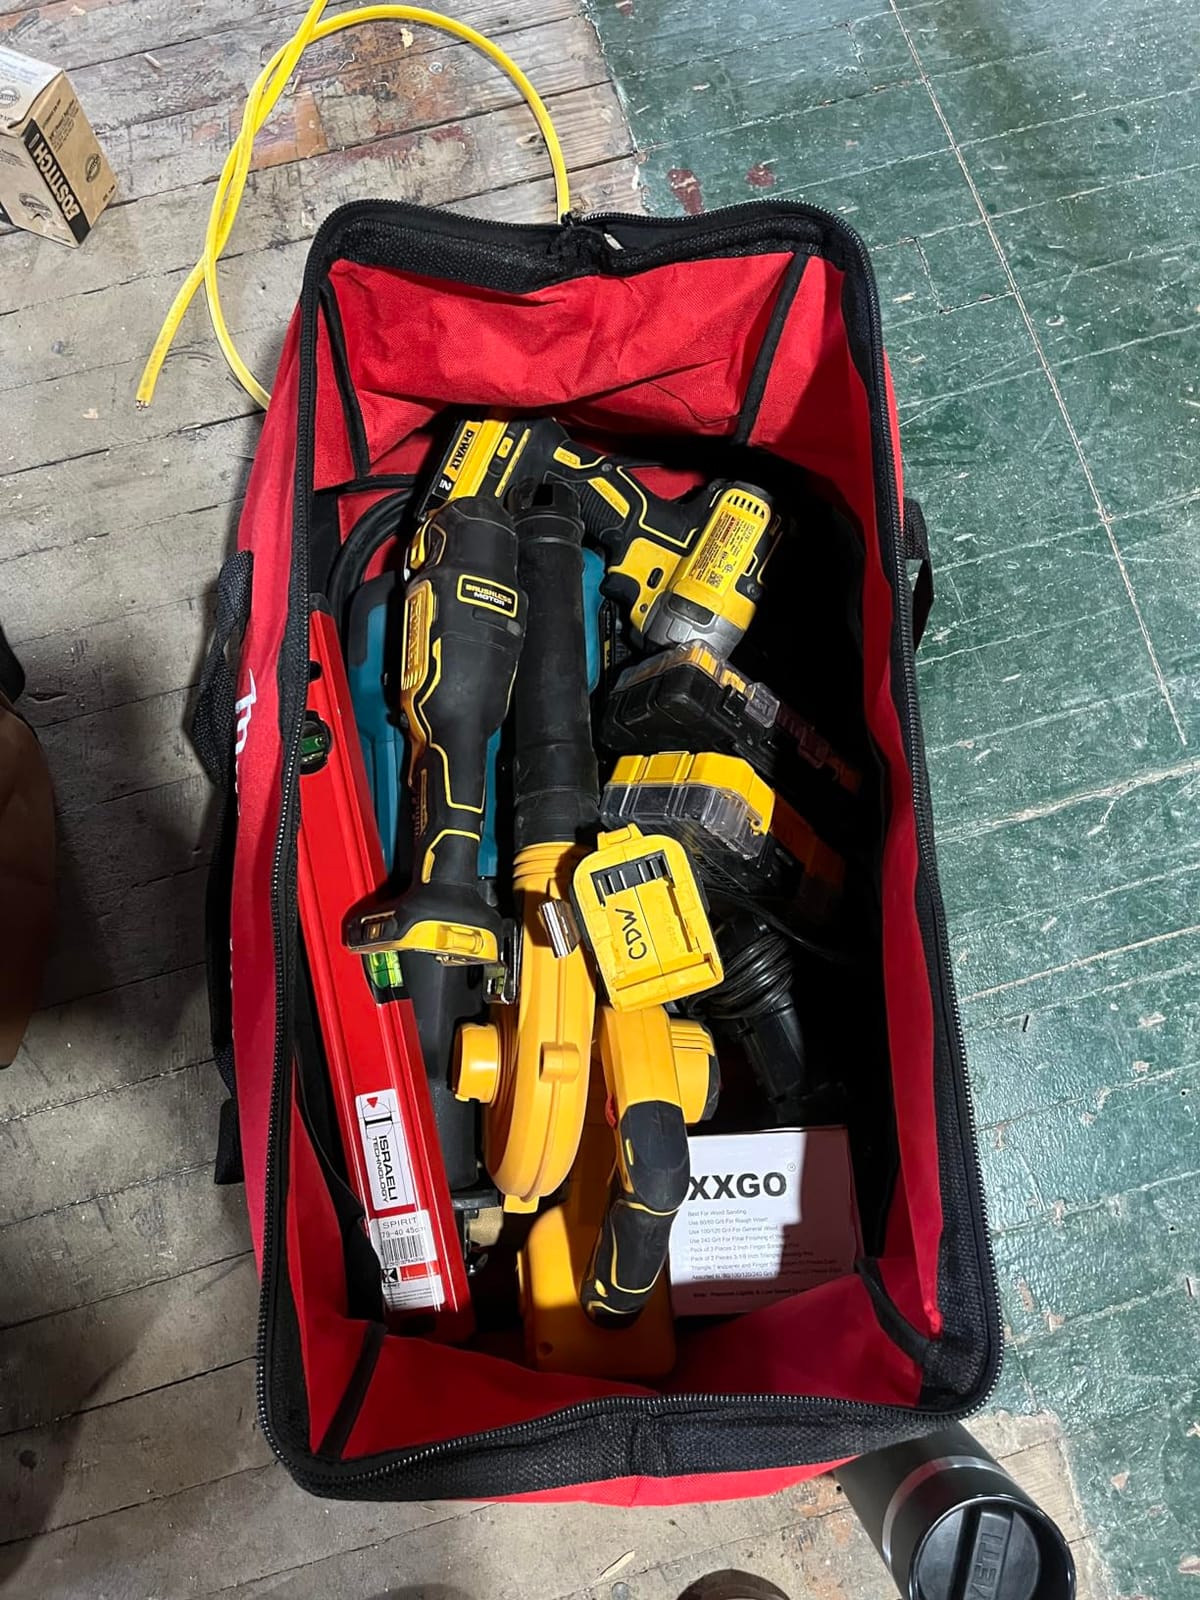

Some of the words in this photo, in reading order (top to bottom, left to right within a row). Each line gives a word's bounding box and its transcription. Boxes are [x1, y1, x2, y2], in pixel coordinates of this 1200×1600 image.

[371, 1136, 390, 1203] TECHNOLOGY
[378, 1135, 398, 1201] ISRAELI
[382, 1216, 417, 1230] SPIRIT
